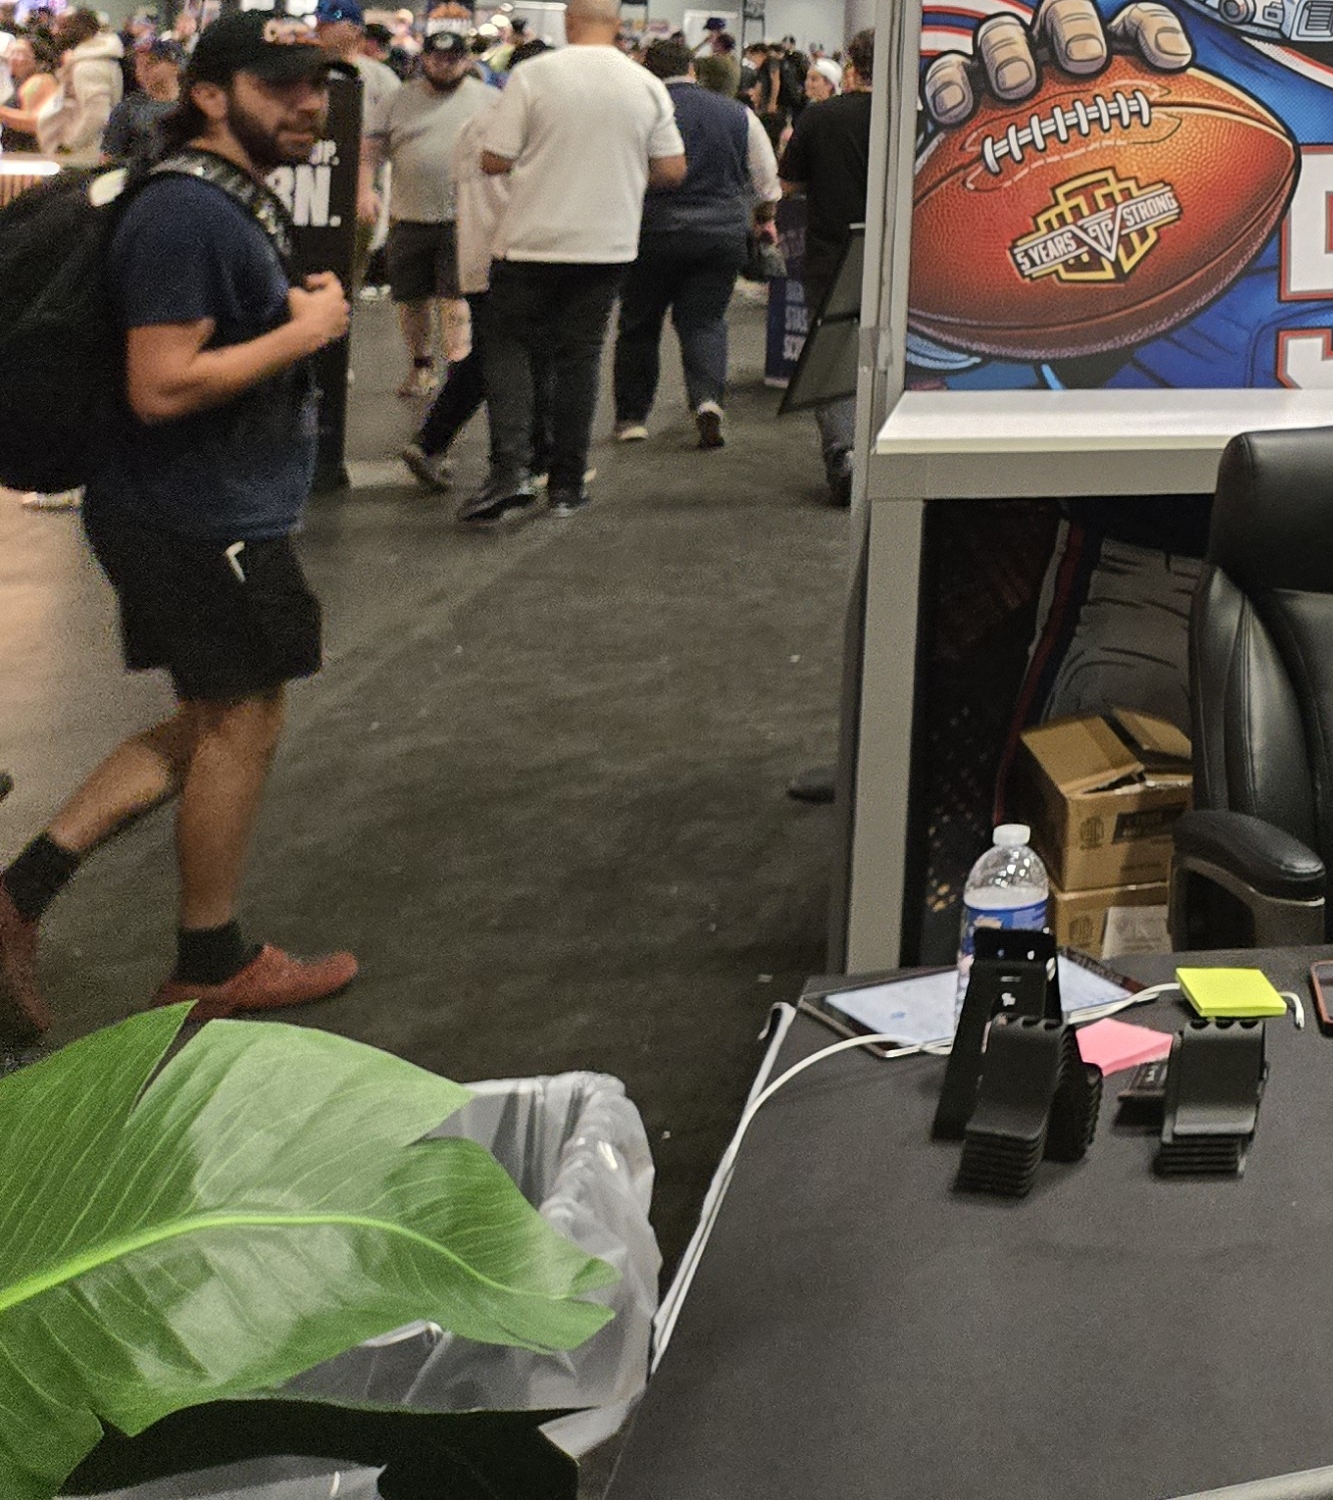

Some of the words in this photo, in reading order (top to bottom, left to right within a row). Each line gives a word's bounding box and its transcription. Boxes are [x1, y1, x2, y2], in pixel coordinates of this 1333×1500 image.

[1015, 251, 1031, 272] 5
[1028, 230, 1078, 266] YEARS
[1121, 191, 1179, 228] STRONG
